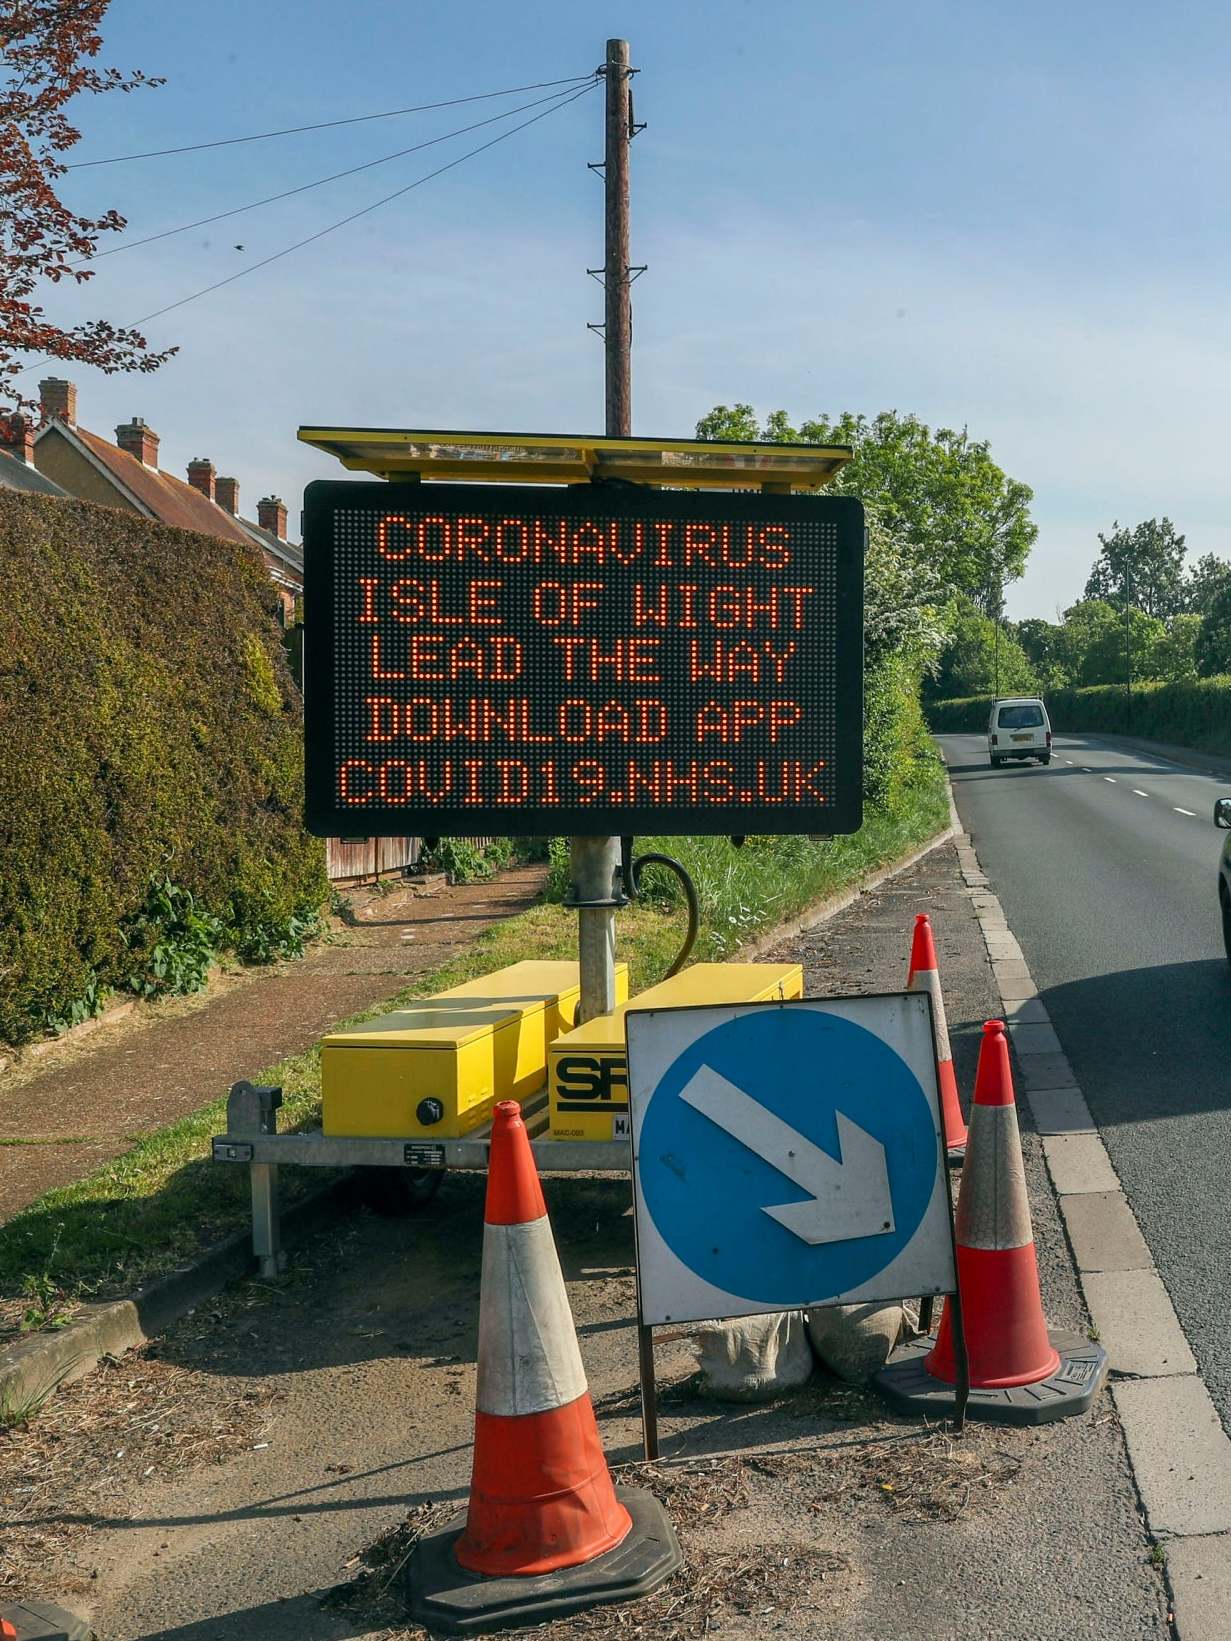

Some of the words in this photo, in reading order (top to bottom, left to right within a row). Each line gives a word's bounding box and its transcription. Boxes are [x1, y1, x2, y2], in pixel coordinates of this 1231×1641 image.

[378, 515, 790, 570] CORONAVIRUS
[358, 577, 503, 625] ISLE
[533, 581, 605, 626] OF
[634, 583, 814, 630] WIGHT
[372, 634, 522, 681] LEAD
[552, 637, 661, 682] THE
[690, 639, 796, 684] WAY
[365, 696, 667, 743] DOWNLOAD
[696, 699, 802, 743] APP
[339, 759, 825, 804] COVID19.NHS.UK
